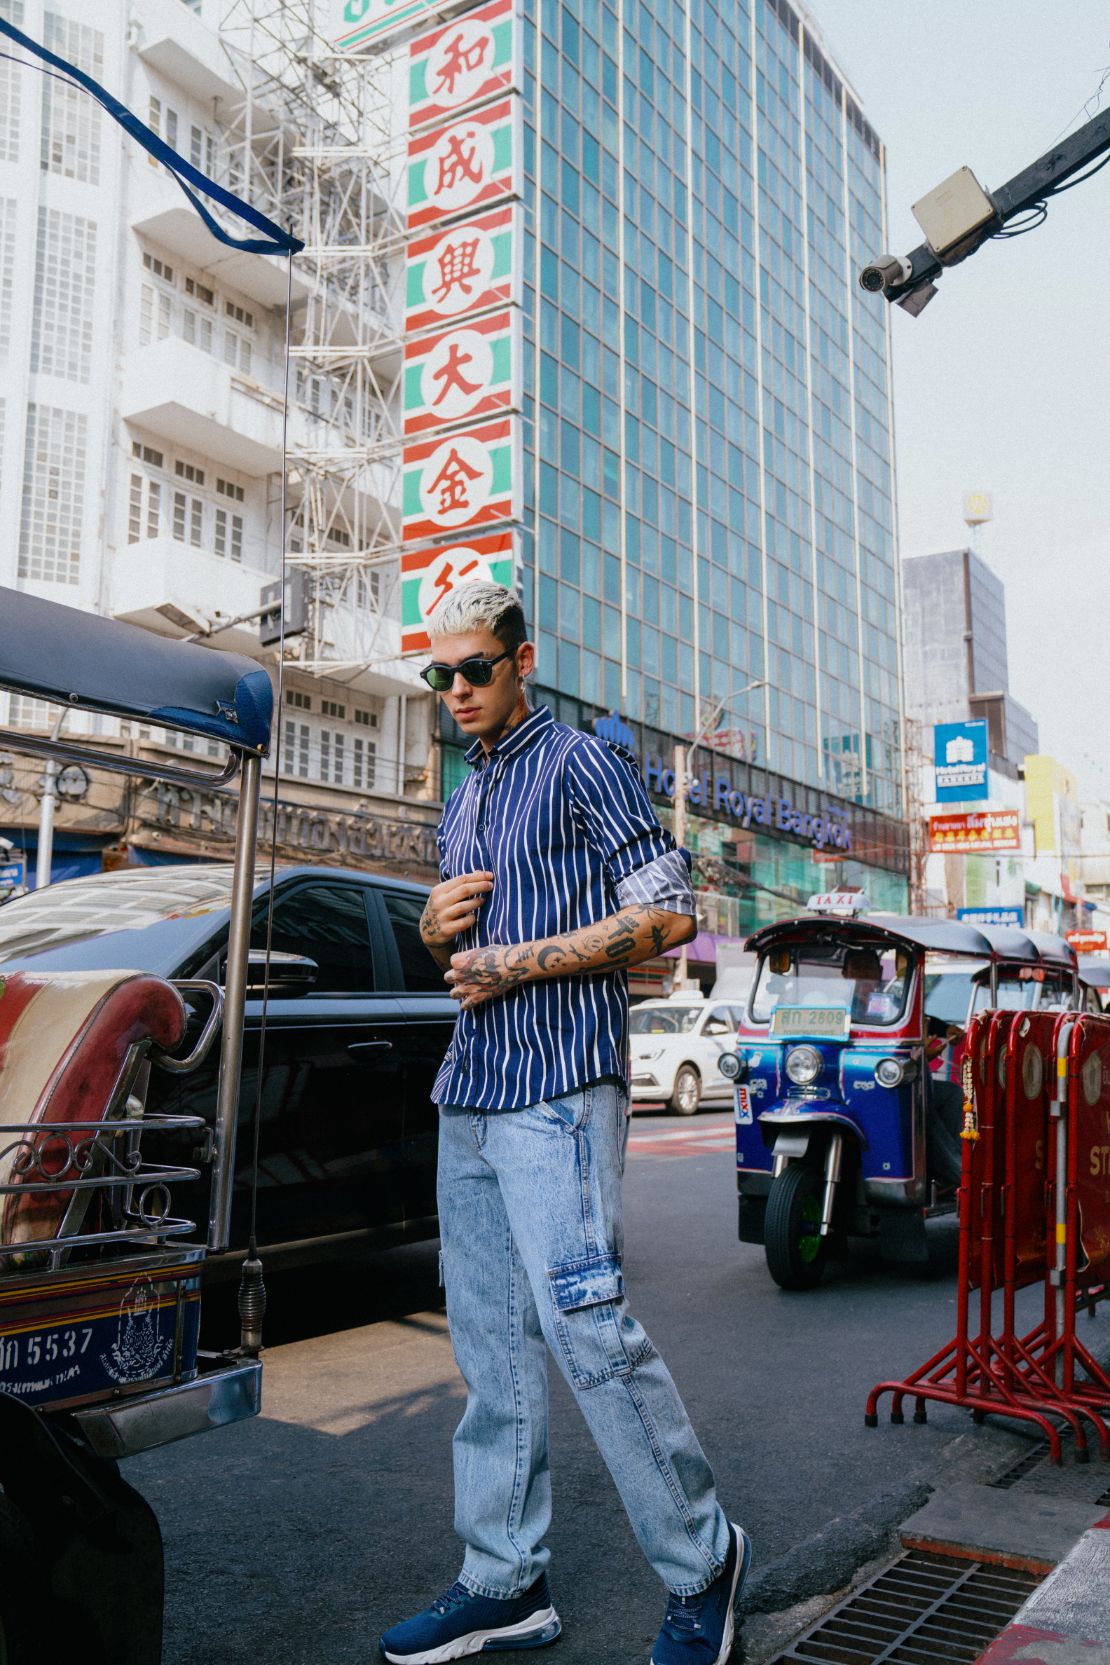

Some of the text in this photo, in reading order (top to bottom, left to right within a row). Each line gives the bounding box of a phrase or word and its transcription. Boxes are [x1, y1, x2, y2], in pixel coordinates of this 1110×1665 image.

[644, 751, 852, 850] Hoel Royal Bangkok
[816, 895, 853, 905] TAXI
[27, 1328, 93, 1365] 5537
